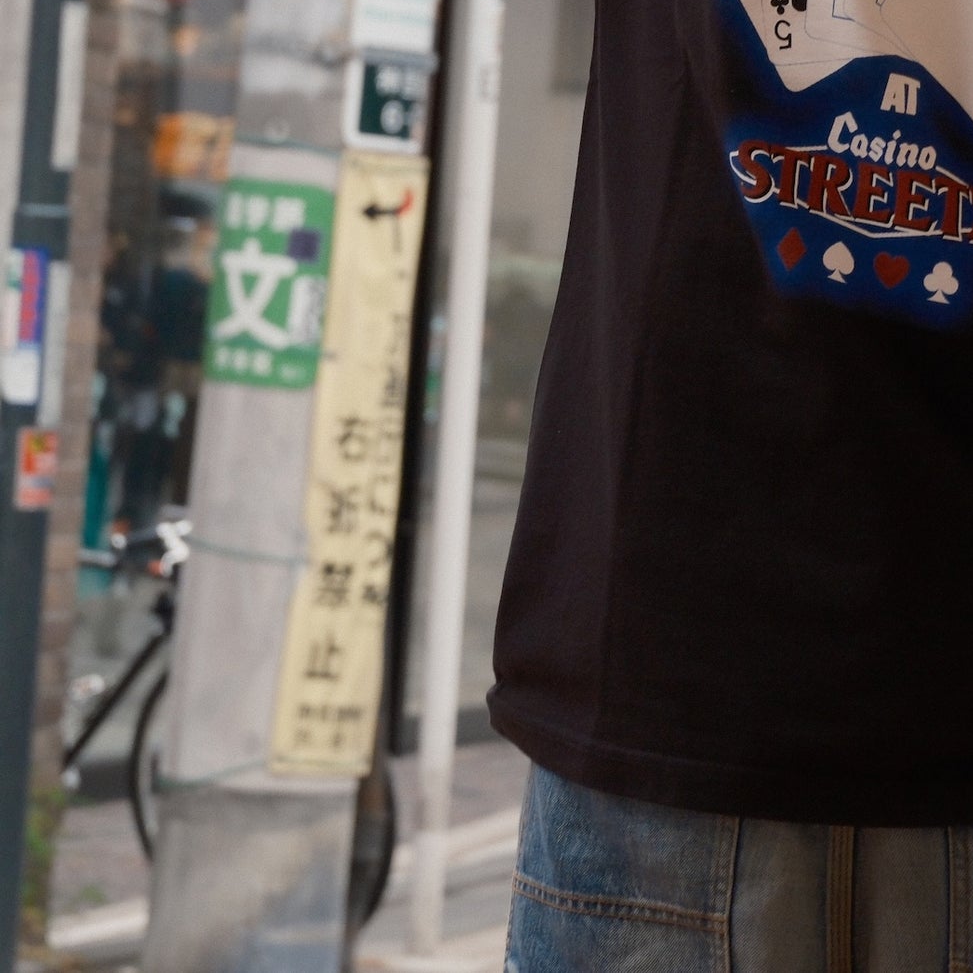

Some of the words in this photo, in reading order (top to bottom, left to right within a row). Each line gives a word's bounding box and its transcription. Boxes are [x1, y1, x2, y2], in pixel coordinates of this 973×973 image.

[774, 19, 793, 50] 5
[880, 72, 921, 116] AT
[826, 111, 938, 172] Casino
